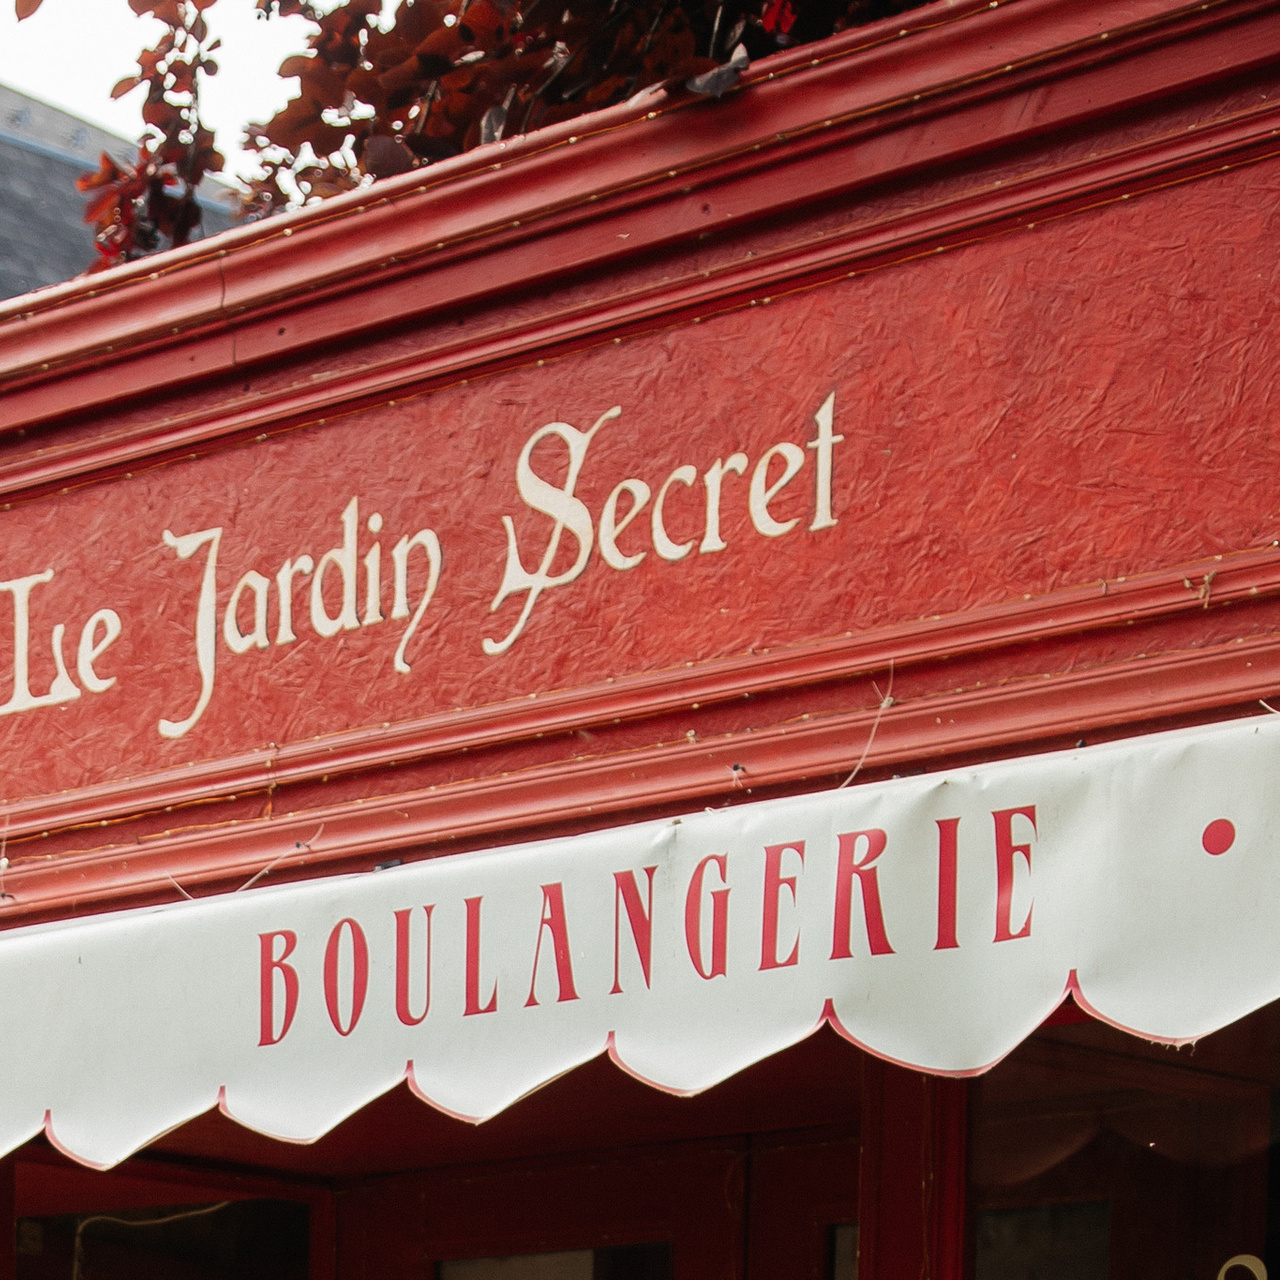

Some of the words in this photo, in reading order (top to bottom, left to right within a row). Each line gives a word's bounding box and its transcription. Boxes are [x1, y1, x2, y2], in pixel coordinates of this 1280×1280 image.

[157, 495, 442, 738] Jardin
[483, 391, 845, 655] Secret
[257, 804, 1040, 1048] BOULANGERIE
